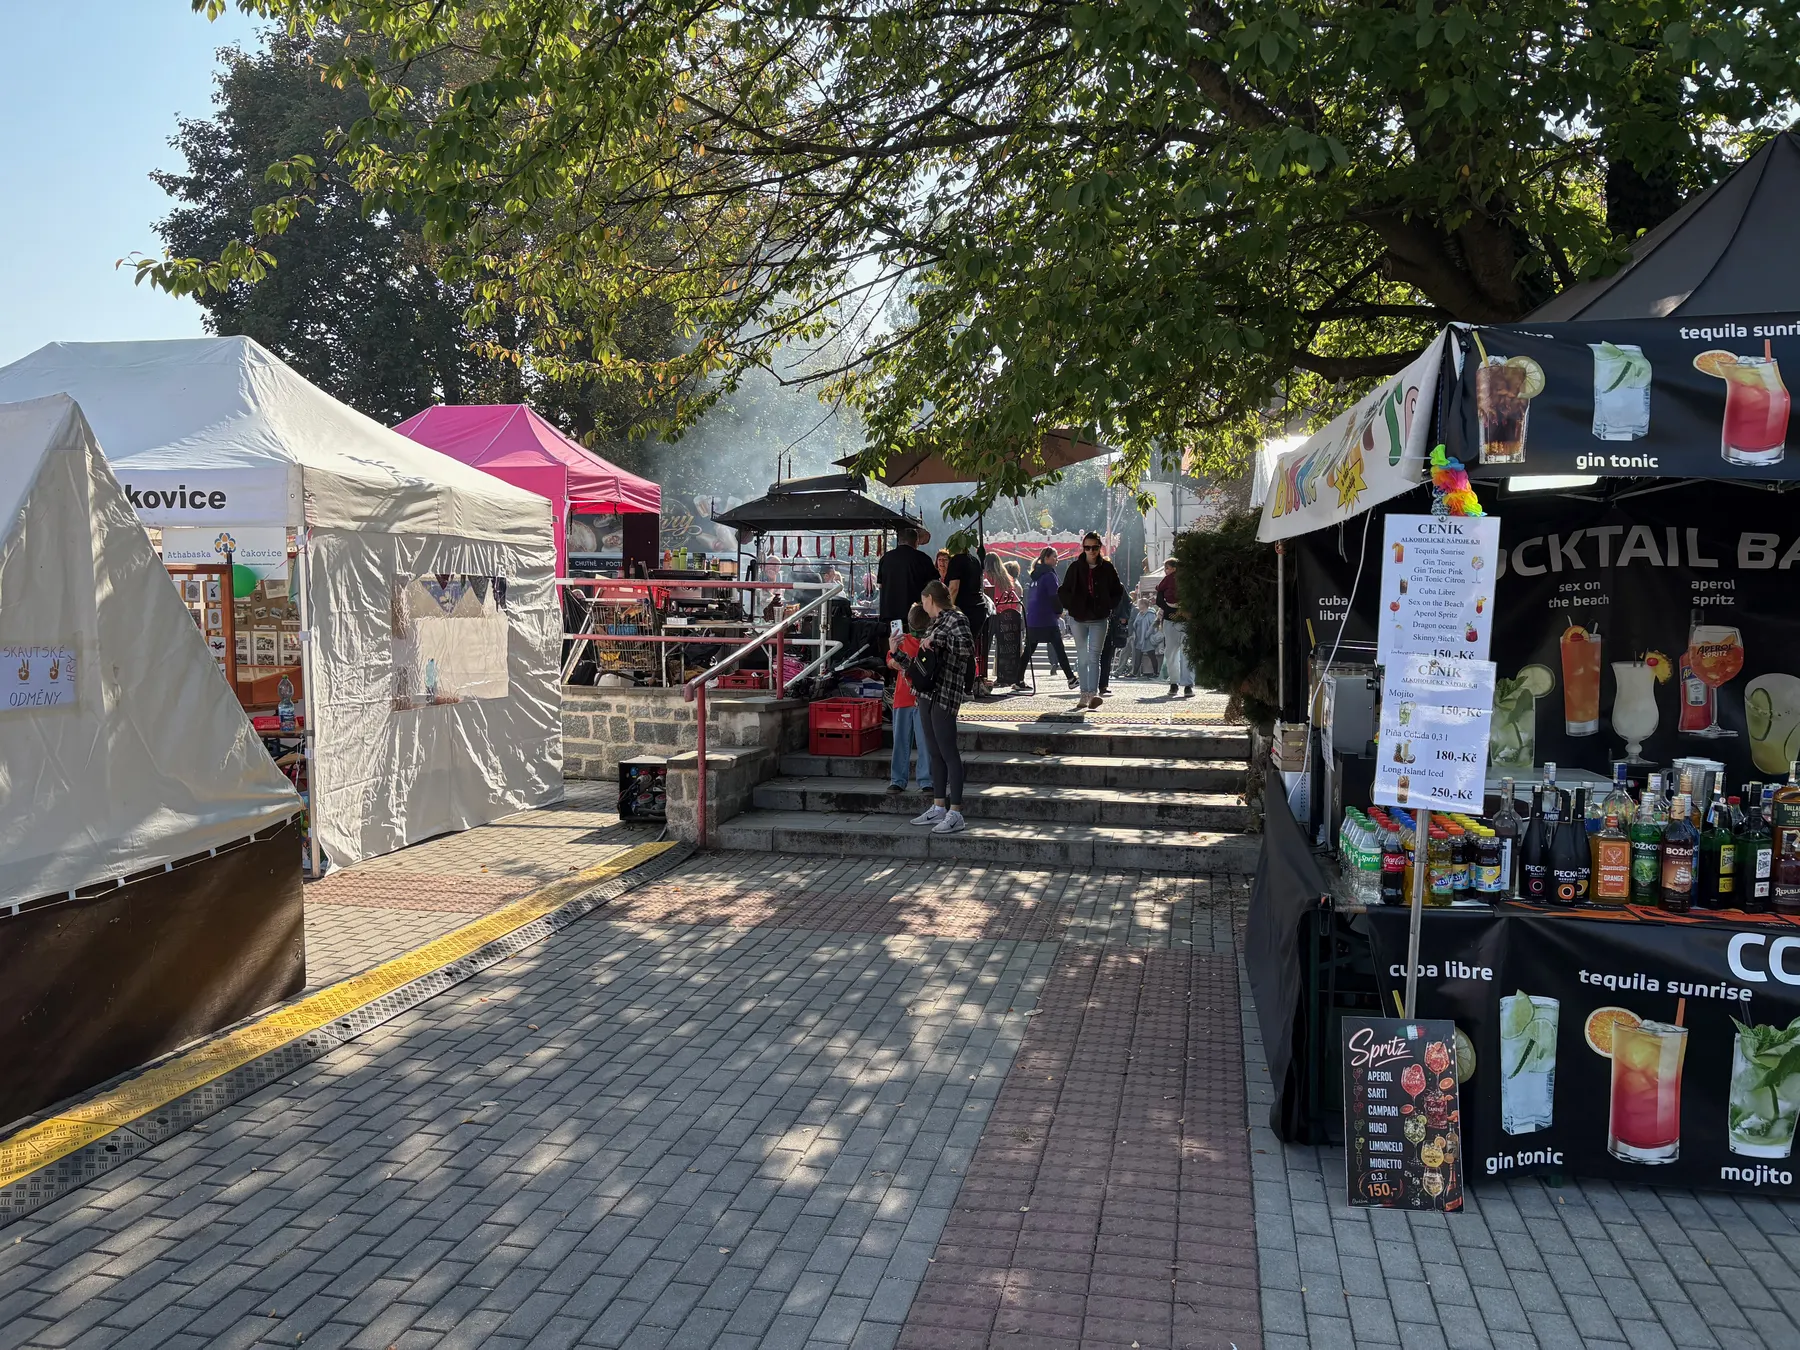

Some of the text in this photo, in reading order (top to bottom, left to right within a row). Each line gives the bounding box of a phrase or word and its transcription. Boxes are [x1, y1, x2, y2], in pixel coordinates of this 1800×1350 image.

[1679, 323, 1748, 341] tequila
[1576, 452, 1659, 470] gin tonic
[1417, 521, 1464, 535] CENÍK
[167, 549, 283, 559] Athabaska Čakovice
[1414, 547, 1466, 556] Tequila Sunrise
[1422, 558, 1456, 567] Gin Tonic
[1413, 566, 1427, 574] Gin
[1428, 567, 1445, 575] Tonic
[1425, 575, 1443, 583] Tonic
[1444, 576, 1466, 584] Citron
[1690, 579, 1736, 591] aperol
[1419, 587, 1456, 596] Cuba Libre
[1558, 580, 1601, 592] sex on
[1318, 595, 1349, 606] cuba
[1443, 600, 1465, 608] Beach
[1548, 594, 1610, 608] the beach
[1692, 593, 1735, 607] spritz
[1319, 610, 1347, 621] libre
[1413, 610, 1458, 619] Aperol Spritz
[1412, 621, 1437, 630] Dragon
[1412, 634, 1455, 643] Skinny Bitch
[3, 644, 67, 659] SKAUTSKÉ
[1697, 644, 1733, 654] APEROL
[1702, 651, 1728, 659] SPRITZ
[66, 654, 77, 682] HRY
[1418, 664, 1462, 678] CENÍK
[9, 688, 63, 707] ODMĚNY
[1388, 688, 1414, 698] Mojito
[1440, 705, 1482, 717] 150,-Kč
[1403, 730, 1430, 740] Colada
[1431, 732, 1443, 740] 0,3
[1435, 750, 1477, 763] 180,-Kč
[1382, 765, 1444, 778] Long Island Iced
[1431, 786, 1473, 800] 250,-Kč
[1361, 855, 1380, 863] Sprite
[1445, 960, 1493, 981] libre
[1578, 969, 1753, 1001] tequila sunrise
[1349, 1028, 1410, 1067] Spritz
[1367, 1071, 1393, 1082] APEROL
[1367, 1087, 1388, 1099] SARTI
[1368, 1105, 1399, 1117] CAMPARI
[1368, 1122, 1387, 1134] HUGO
[1369, 1141, 1403, 1152] LIMONCELO
[1369, 1158, 1402, 1169] MIONETTO
[1485, 1146, 1564, 1175] gin tonic
[1371, 1172, 1384, 1181] 0,3
[1720, 1164, 1793, 1187] mojito
[1367, 1182, 1398, 1197] 150,-
